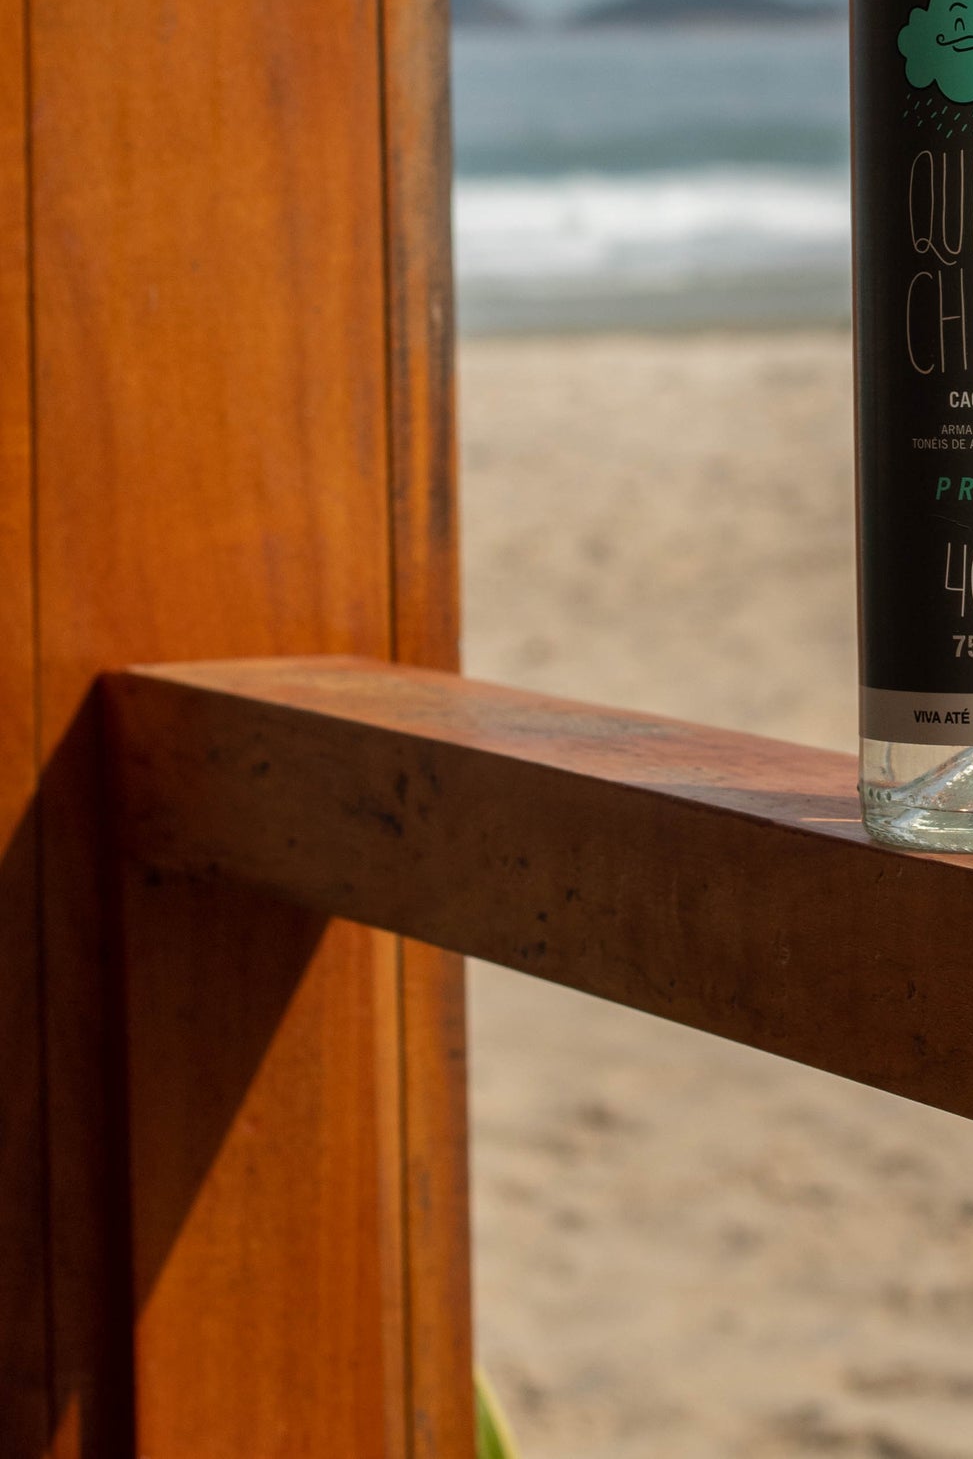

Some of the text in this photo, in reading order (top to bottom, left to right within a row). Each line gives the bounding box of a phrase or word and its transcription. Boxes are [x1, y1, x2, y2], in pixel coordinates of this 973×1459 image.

[912, 436, 949, 450] TONÉIS
[951, 438, 966, 450] DE
[913, 710, 942, 724] VIVA
[944, 708, 970, 725] ATÉ
